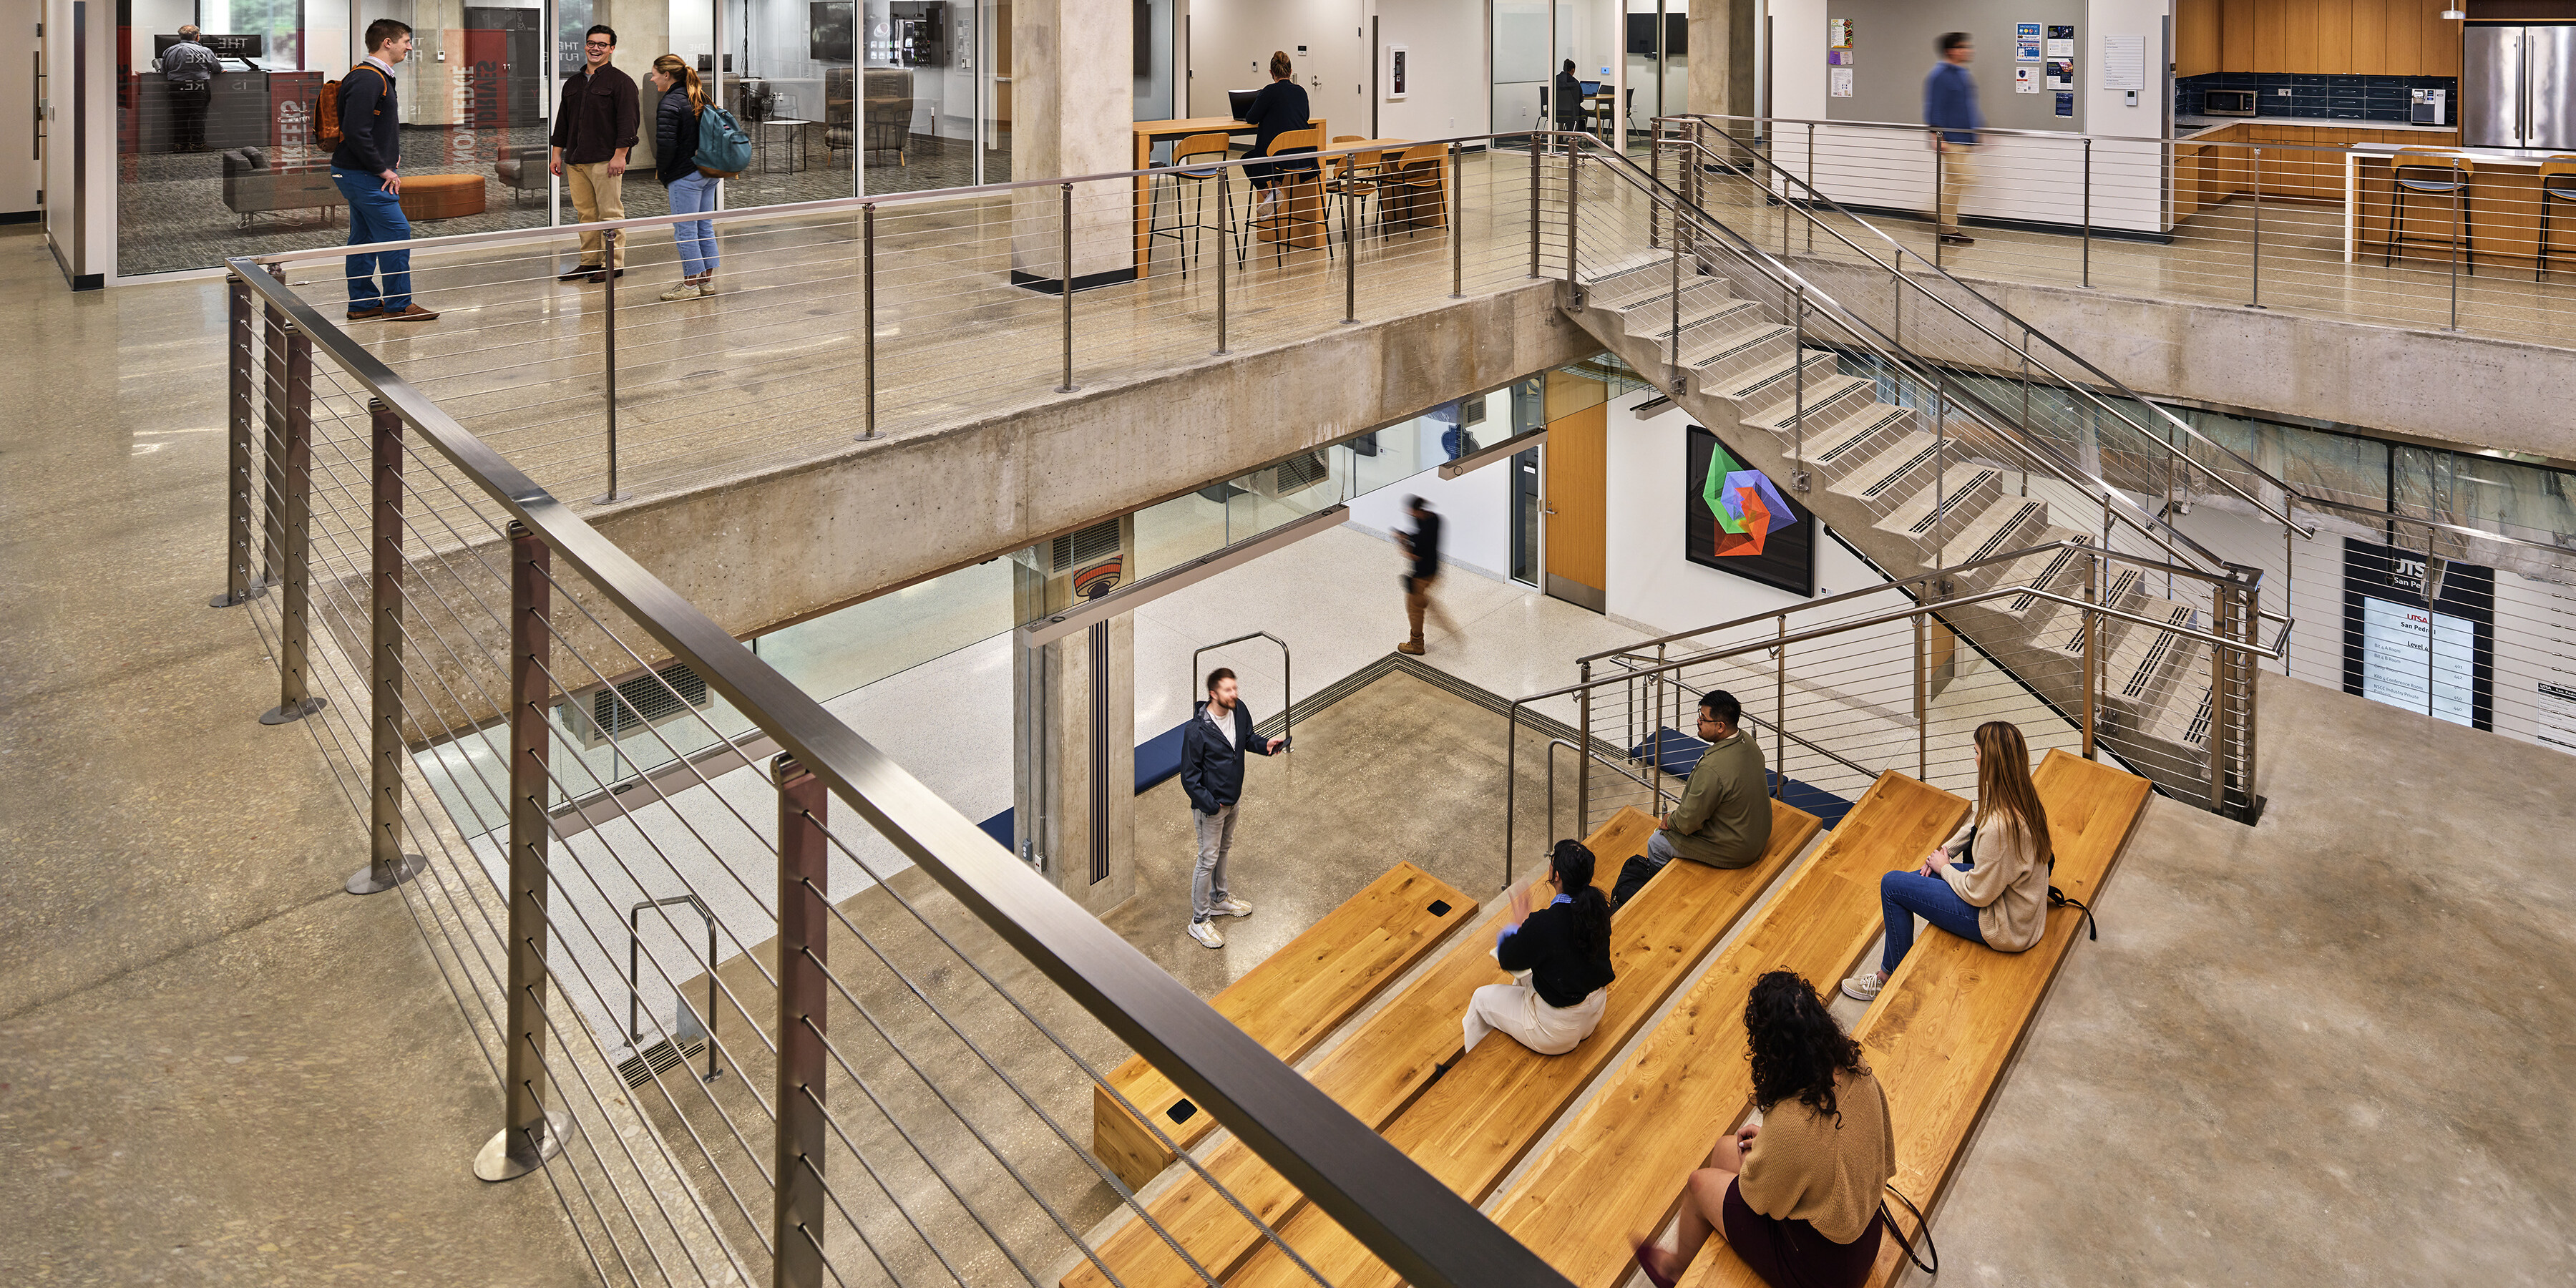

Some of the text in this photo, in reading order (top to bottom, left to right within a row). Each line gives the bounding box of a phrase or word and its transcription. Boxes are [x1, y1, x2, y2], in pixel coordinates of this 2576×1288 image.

[2394, 577, 2409, 586] San
[2406, 613, 2428, 623] UTSA
[2407, 640, 2424, 650] Level
[2386, 677, 2411, 687] Conference
[2386, 687, 2404, 696] Industry
